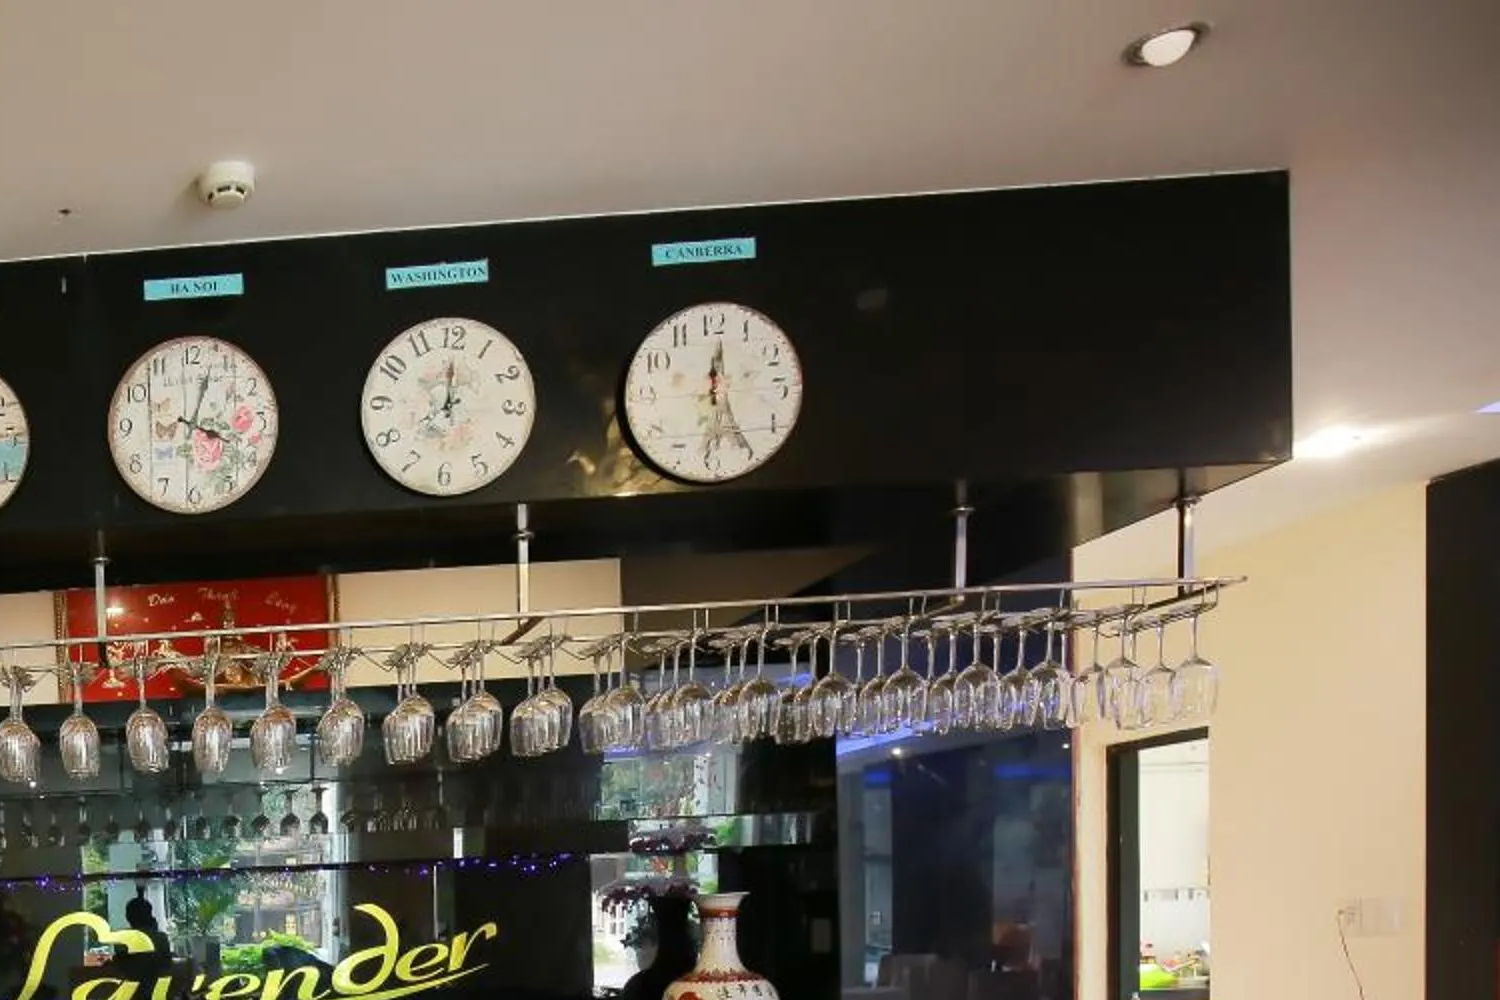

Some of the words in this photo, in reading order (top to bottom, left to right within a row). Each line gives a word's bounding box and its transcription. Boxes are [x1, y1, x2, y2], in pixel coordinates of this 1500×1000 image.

[665, 244, 742, 258] CANBERRA
[390, 267, 486, 283] WASHINGTON
[703, 313, 724, 336] 12
[408, 330, 431, 357] 11
[441, 326, 466, 350] 12
[673, 323, 687, 347] 11
[184, 345, 200, 365] 12
[478, 339, 493, 359] 1
[153, 358, 165, 376] 11
[379, 354, 407, 381] 10
[647, 351, 670, 374] 10
[495, 365, 520, 384] 2
[128, 383, 147, 403] 10
[247, 378, 257, 396] 2
[370, 395, 393, 411] 9
[502, 399, 527, 416] 3
[119, 418, 133, 437] 9
[256, 411, 267, 433] 3
[376, 429, 401, 447] 8
[496, 431, 515, 448] 4
[130, 453, 142, 474] 8
[402, 450, 421, 473] 7
[471, 453, 489, 477] 5
[438, 463, 451, 486] 6
[158, 477, 170, 497] 7
[188, 485, 201, 505] 6
